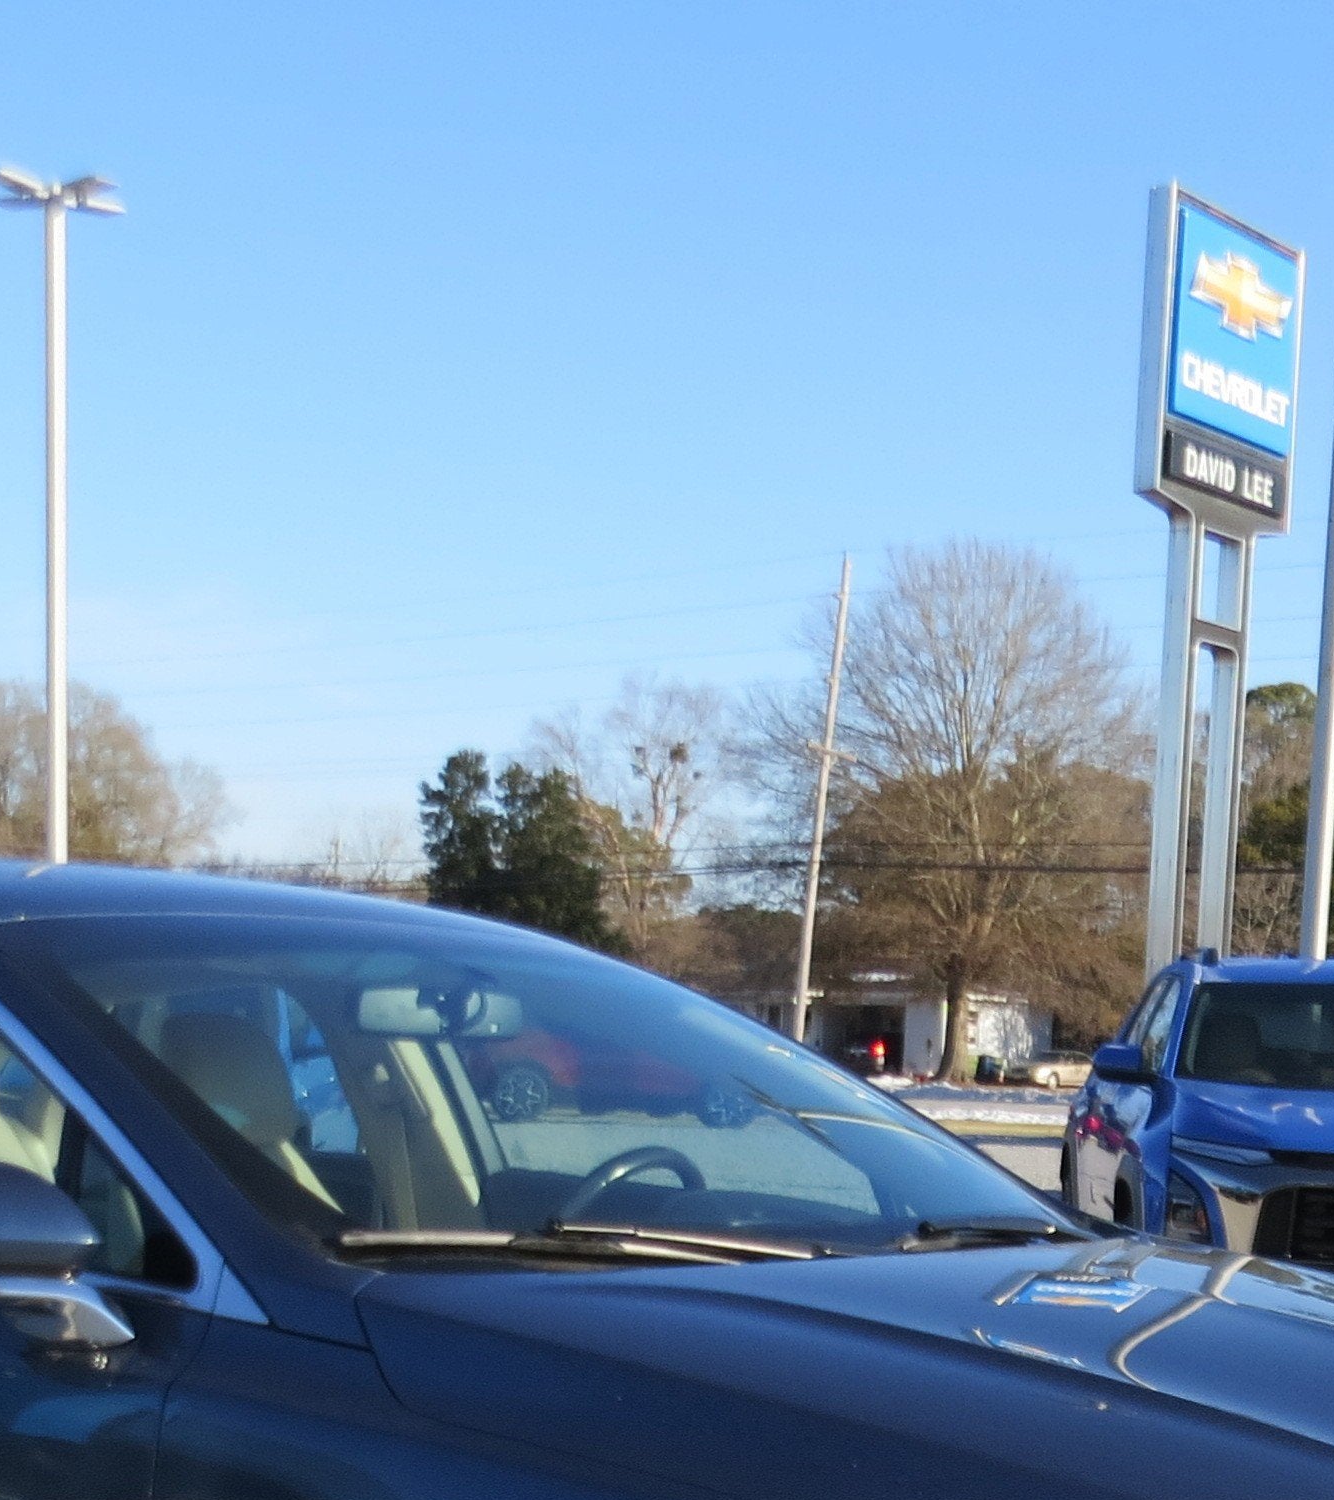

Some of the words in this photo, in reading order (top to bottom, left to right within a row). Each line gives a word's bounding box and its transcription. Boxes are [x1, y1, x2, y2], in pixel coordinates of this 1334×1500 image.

[1180, 349, 1290, 427] CHEVROLET
[1183, 442, 1237, 492] DAVID
[1241, 466, 1274, 508] LEE
